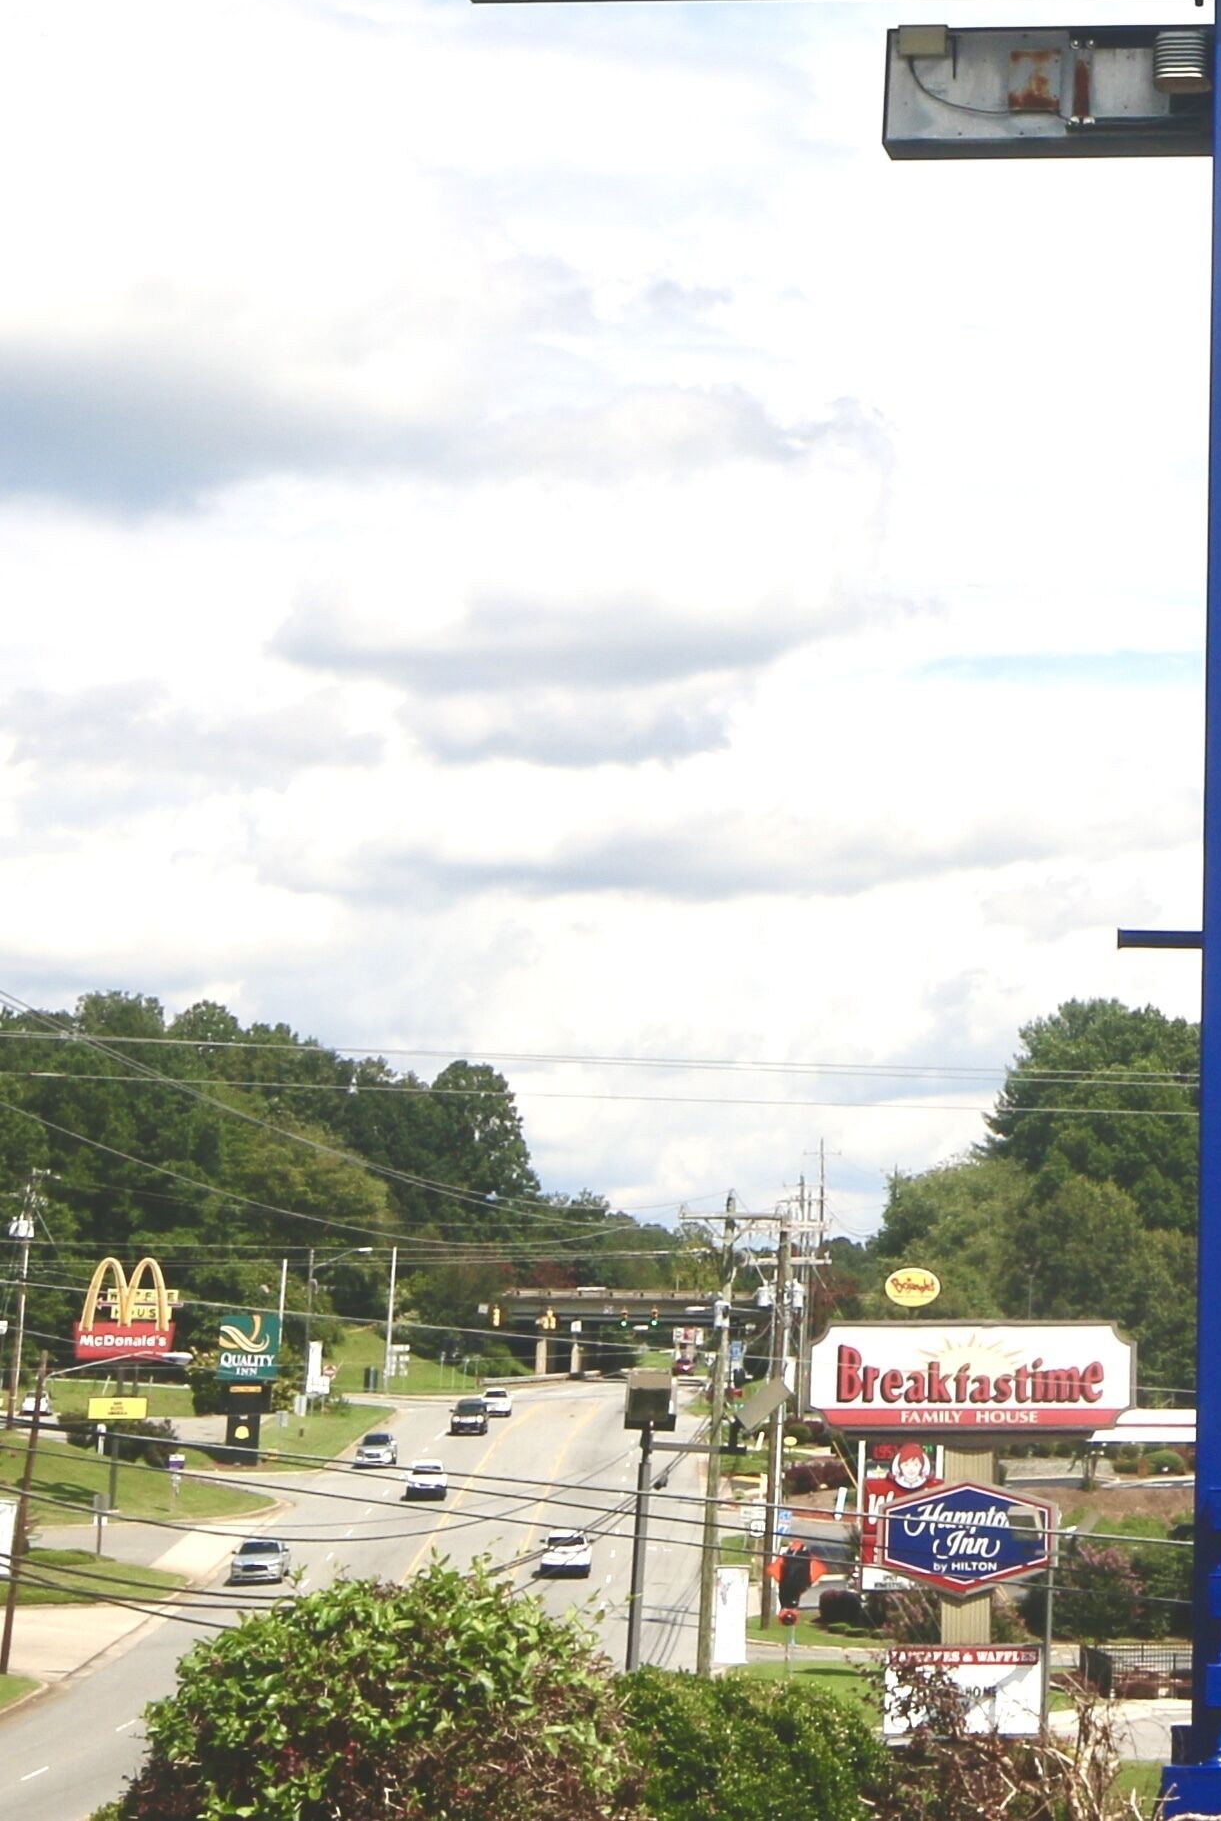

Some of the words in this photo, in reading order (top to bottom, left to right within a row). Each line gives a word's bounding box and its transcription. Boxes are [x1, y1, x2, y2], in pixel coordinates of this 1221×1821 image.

[79, 1334, 167, 1347] McDonald's
[220, 1352, 275, 1368] QUALITY
[235, 1366, 258, 1376] INN
[837, 1344, 1104, 1403] Breakfastime
[901, 1410, 963, 1424] FAMILY
[975, 1410, 1038, 1424] HOUSE
[904, 1502, 1010, 1536] Hampto
[932, 1530, 1001, 1560] Inn
[933, 1562, 947, 1573] by
[951, 1561, 998, 1572] HILTON
[962, 1651, 974, 1663] &
[975, 1650, 1037, 1663] WAFFLES
